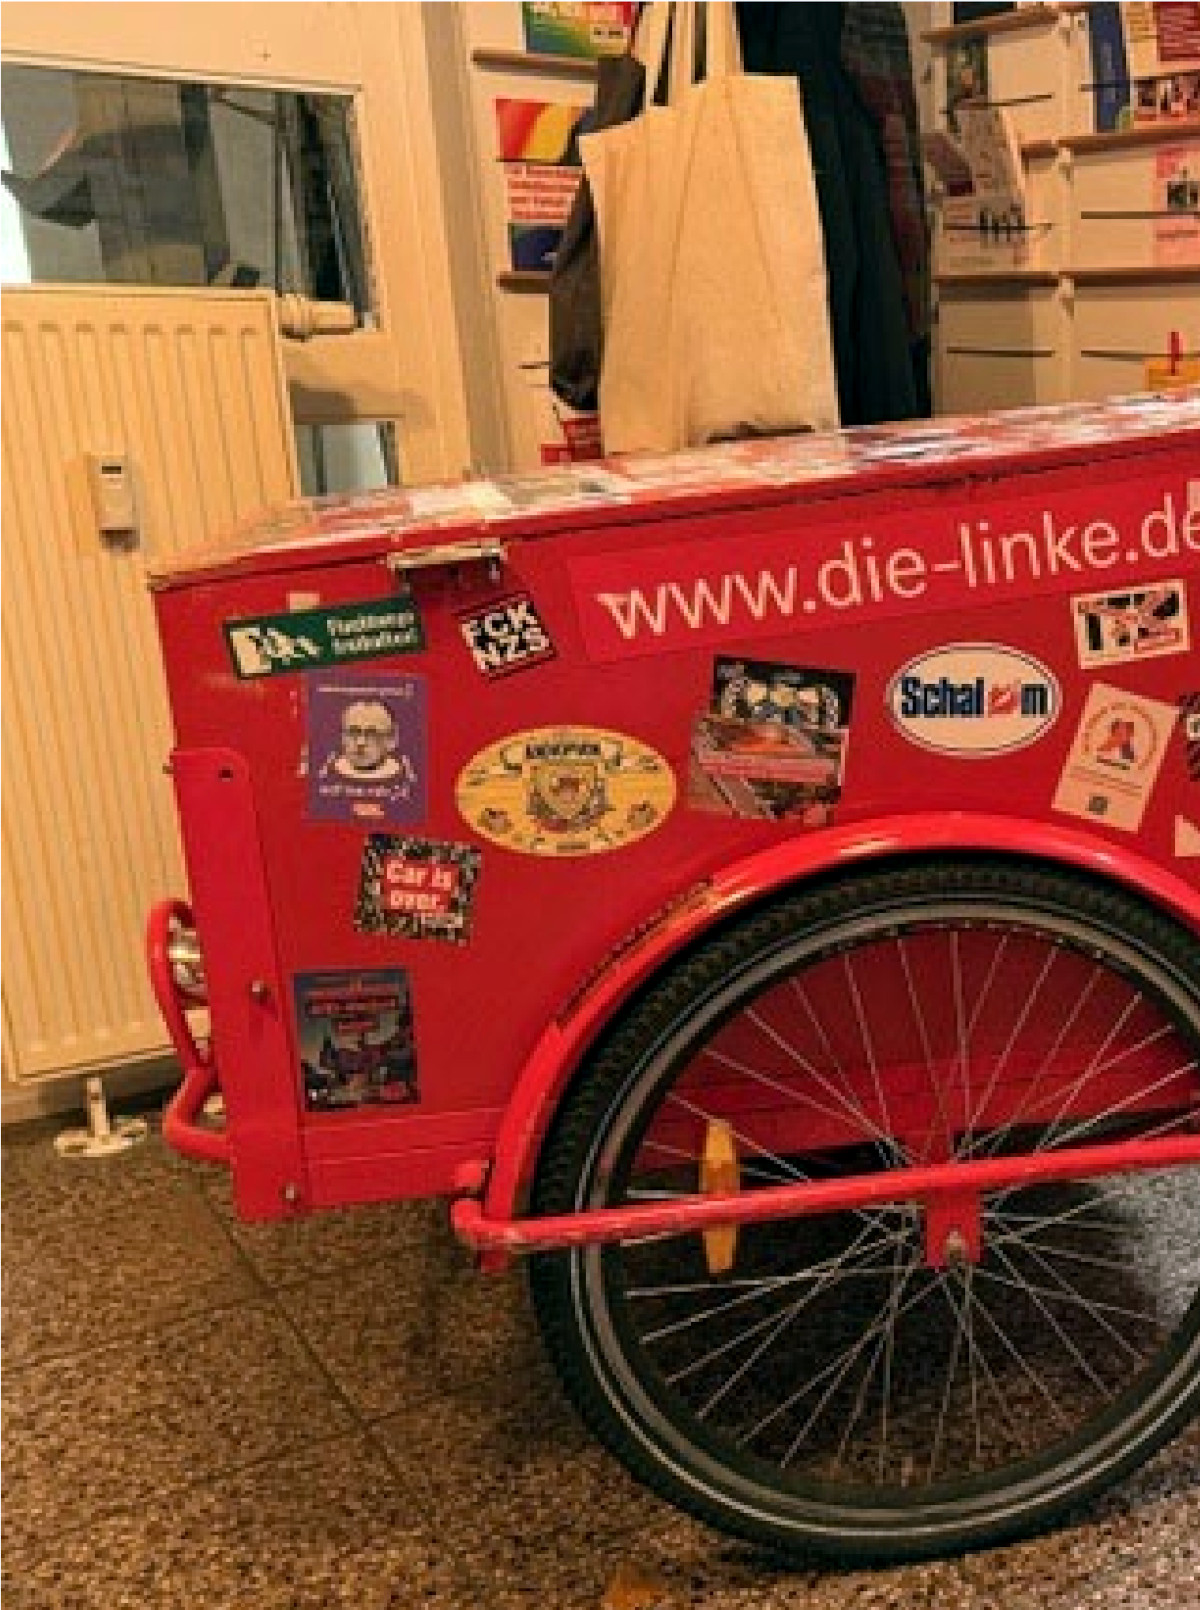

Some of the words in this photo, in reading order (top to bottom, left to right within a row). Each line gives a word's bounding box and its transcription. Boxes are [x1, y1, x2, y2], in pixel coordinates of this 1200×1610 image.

[461, 601, 537, 648] FCK
[472, 627, 550, 672] NZS
[386, 861, 428, 887] Car
